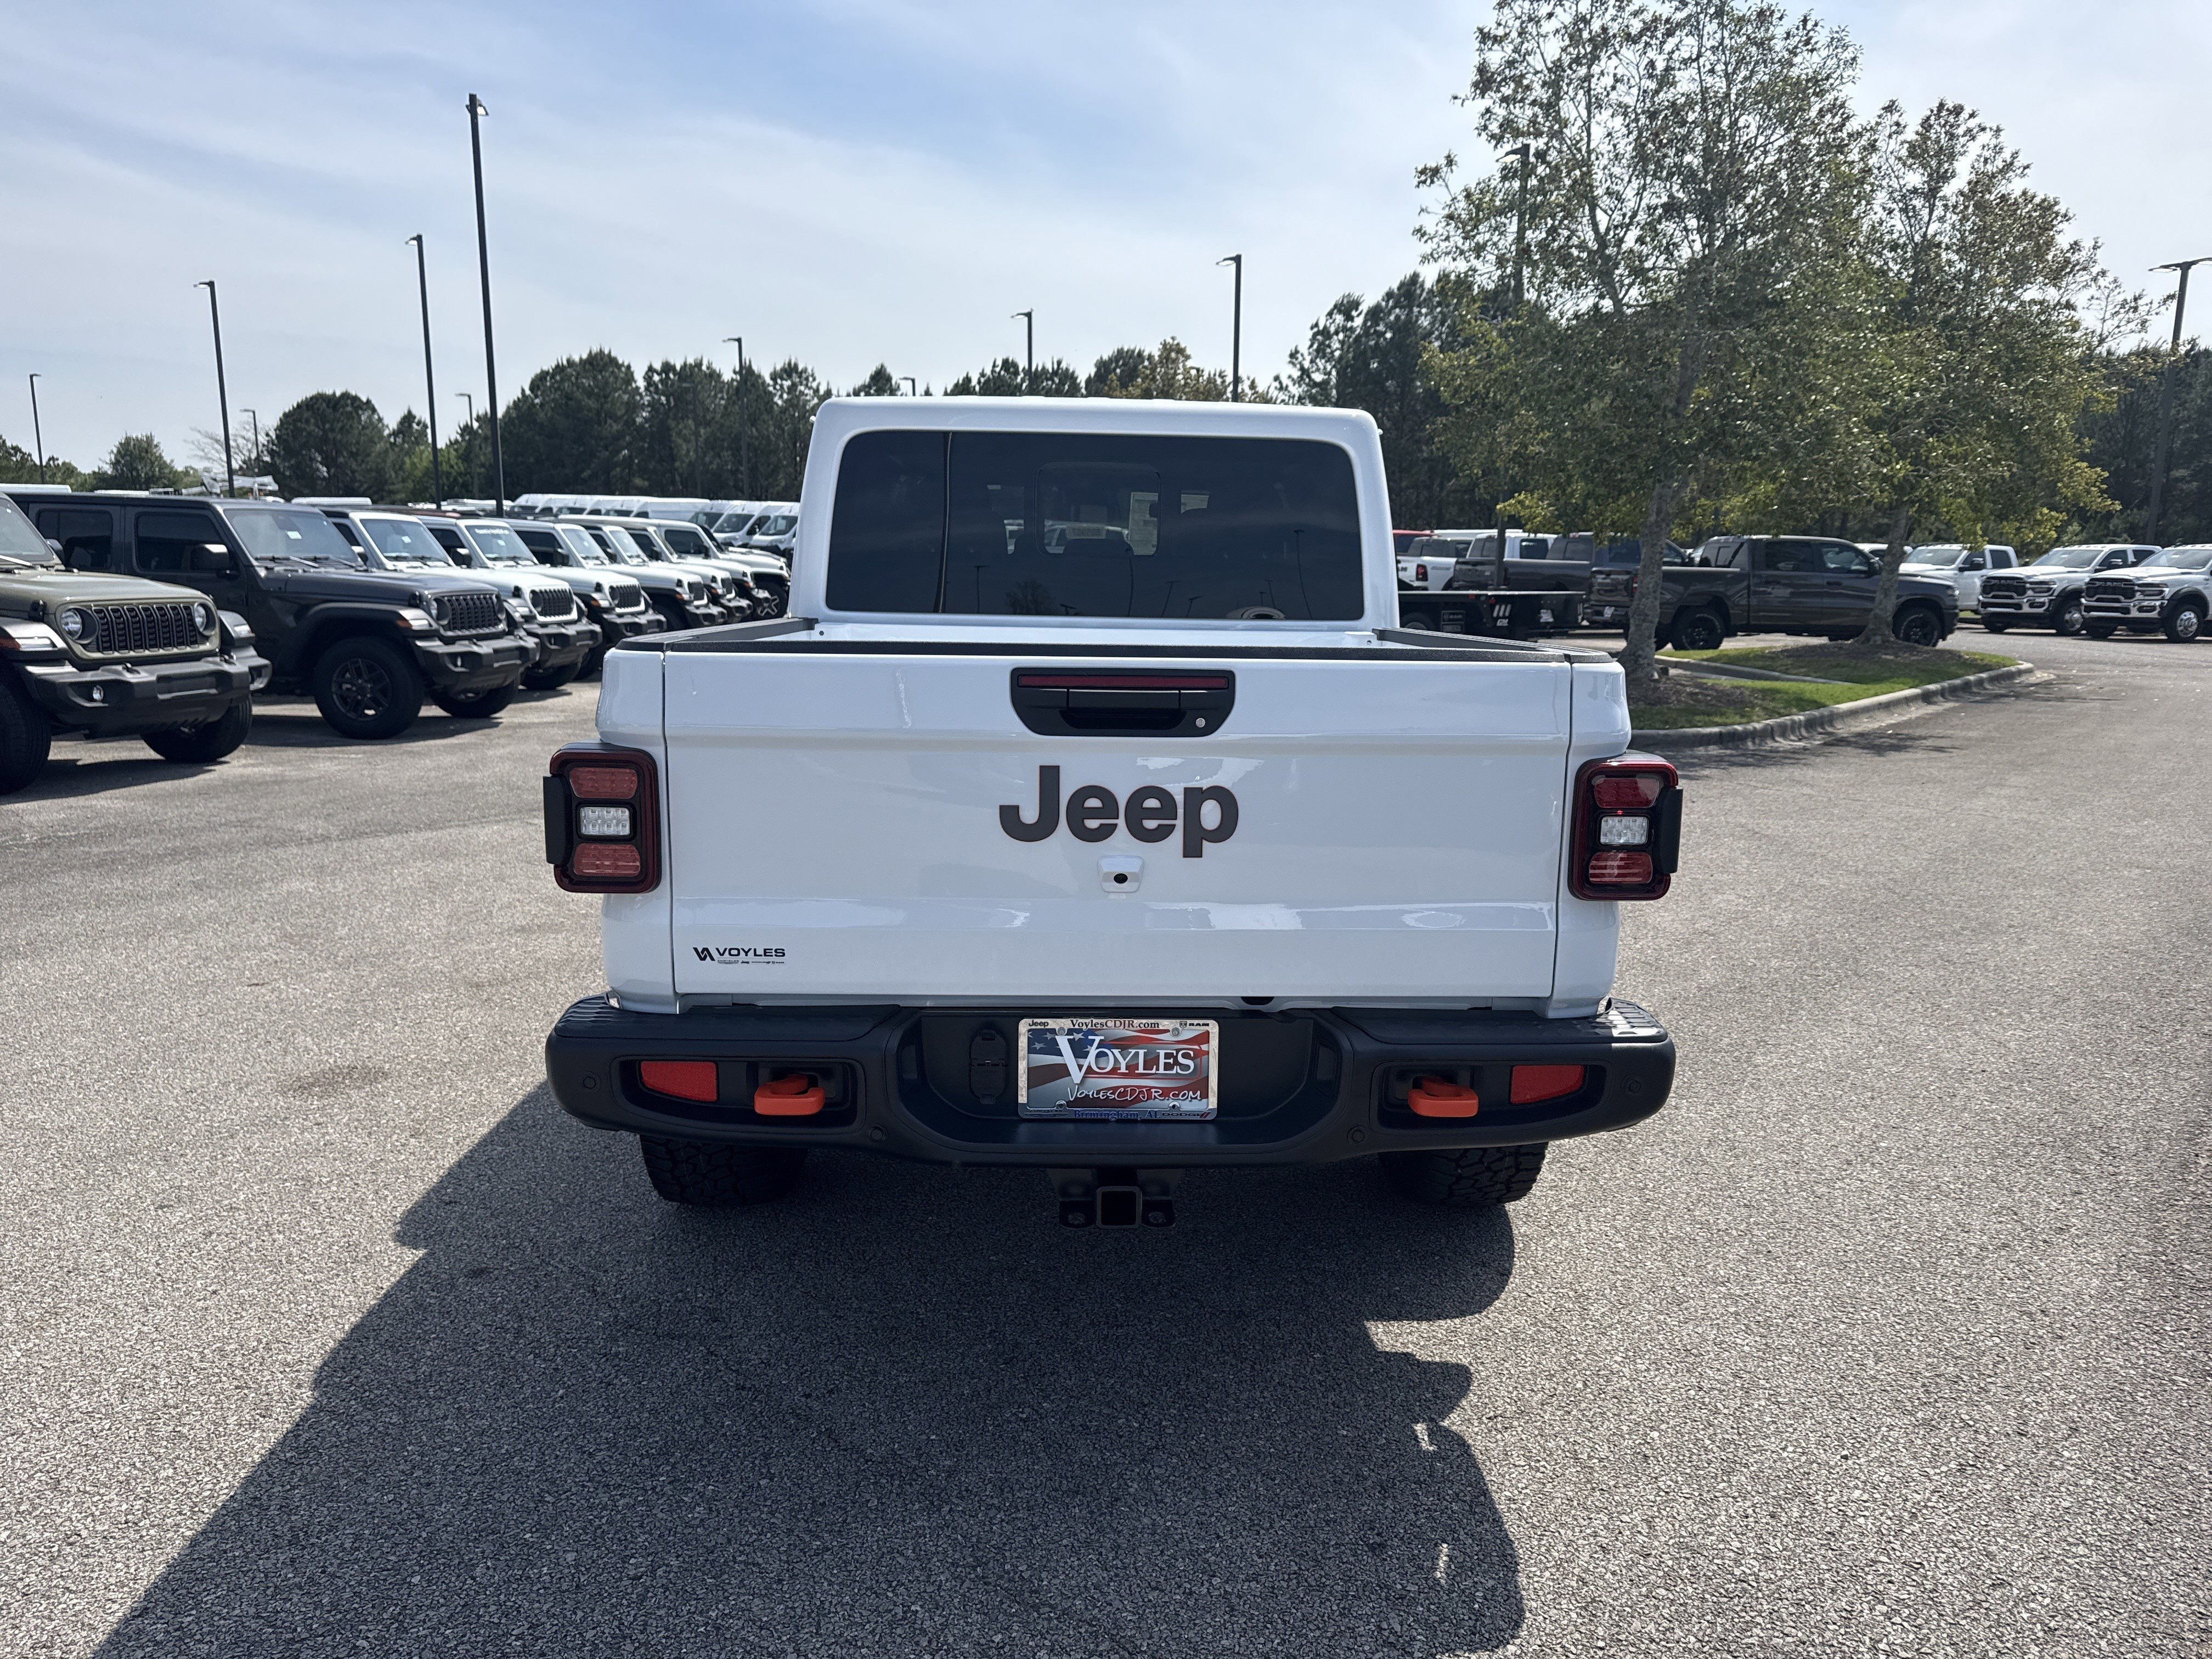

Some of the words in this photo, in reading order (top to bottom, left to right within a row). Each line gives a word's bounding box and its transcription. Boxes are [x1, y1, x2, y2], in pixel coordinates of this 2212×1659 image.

[999, 765, 1239, 858] Jeep
[715, 947, 786, 957] VOYLES
[1070, 1019, 1160, 1030] VoylesCDJR.com
[1055, 1036, 1195, 1084] VOYLES
[1073, 1109, 1142, 1120] Birmingham,
[1145, 1109, 1161, 1119] AL
